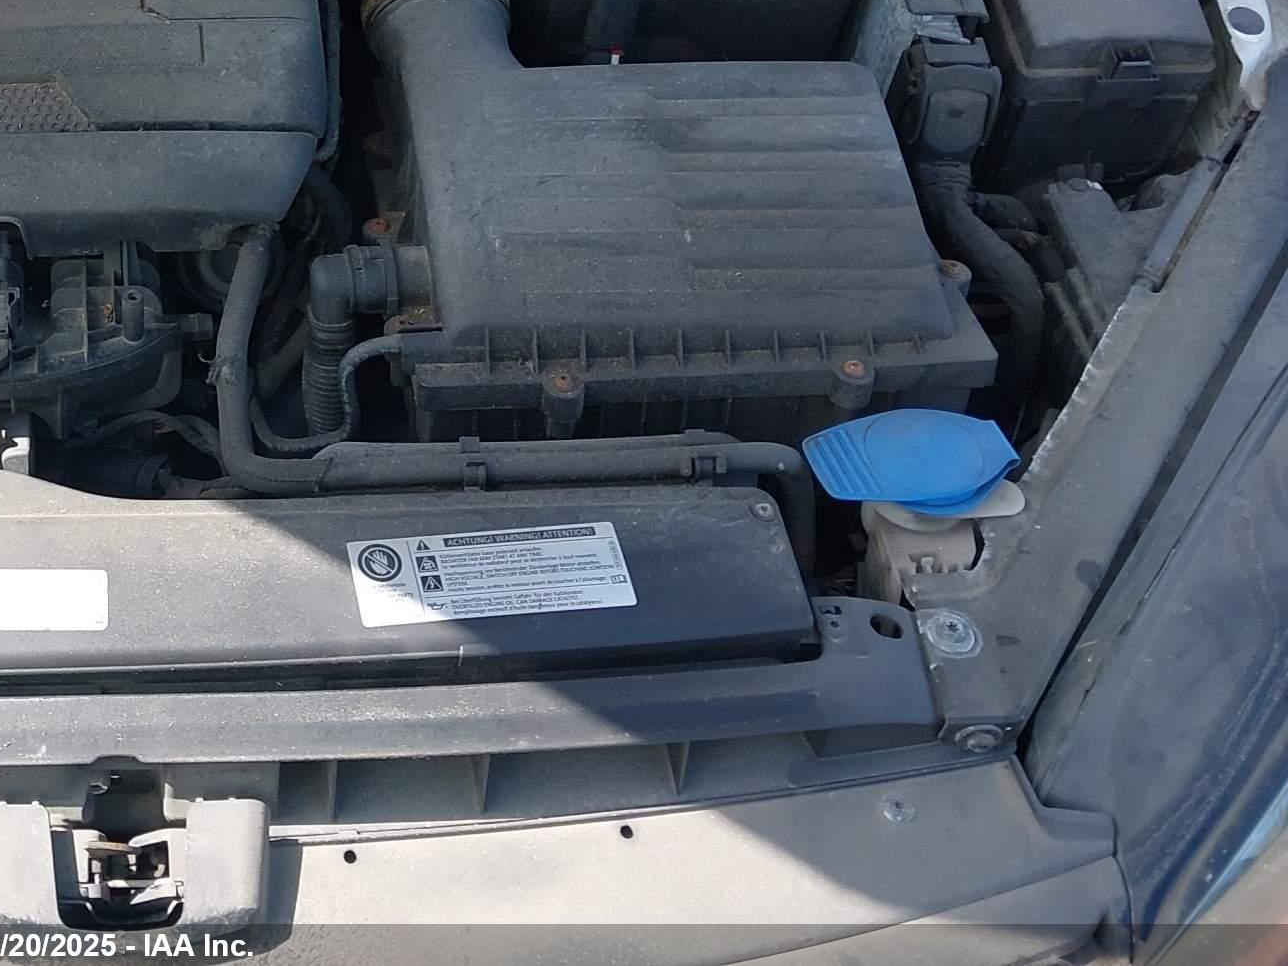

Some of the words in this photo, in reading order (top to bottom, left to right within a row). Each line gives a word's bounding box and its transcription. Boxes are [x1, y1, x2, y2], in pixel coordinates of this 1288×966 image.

[447, 536, 493, 546] ACHTUNG!
[494, 532, 541, 542] WARNING!
[542, 528, 593, 539] ATTENTION!
